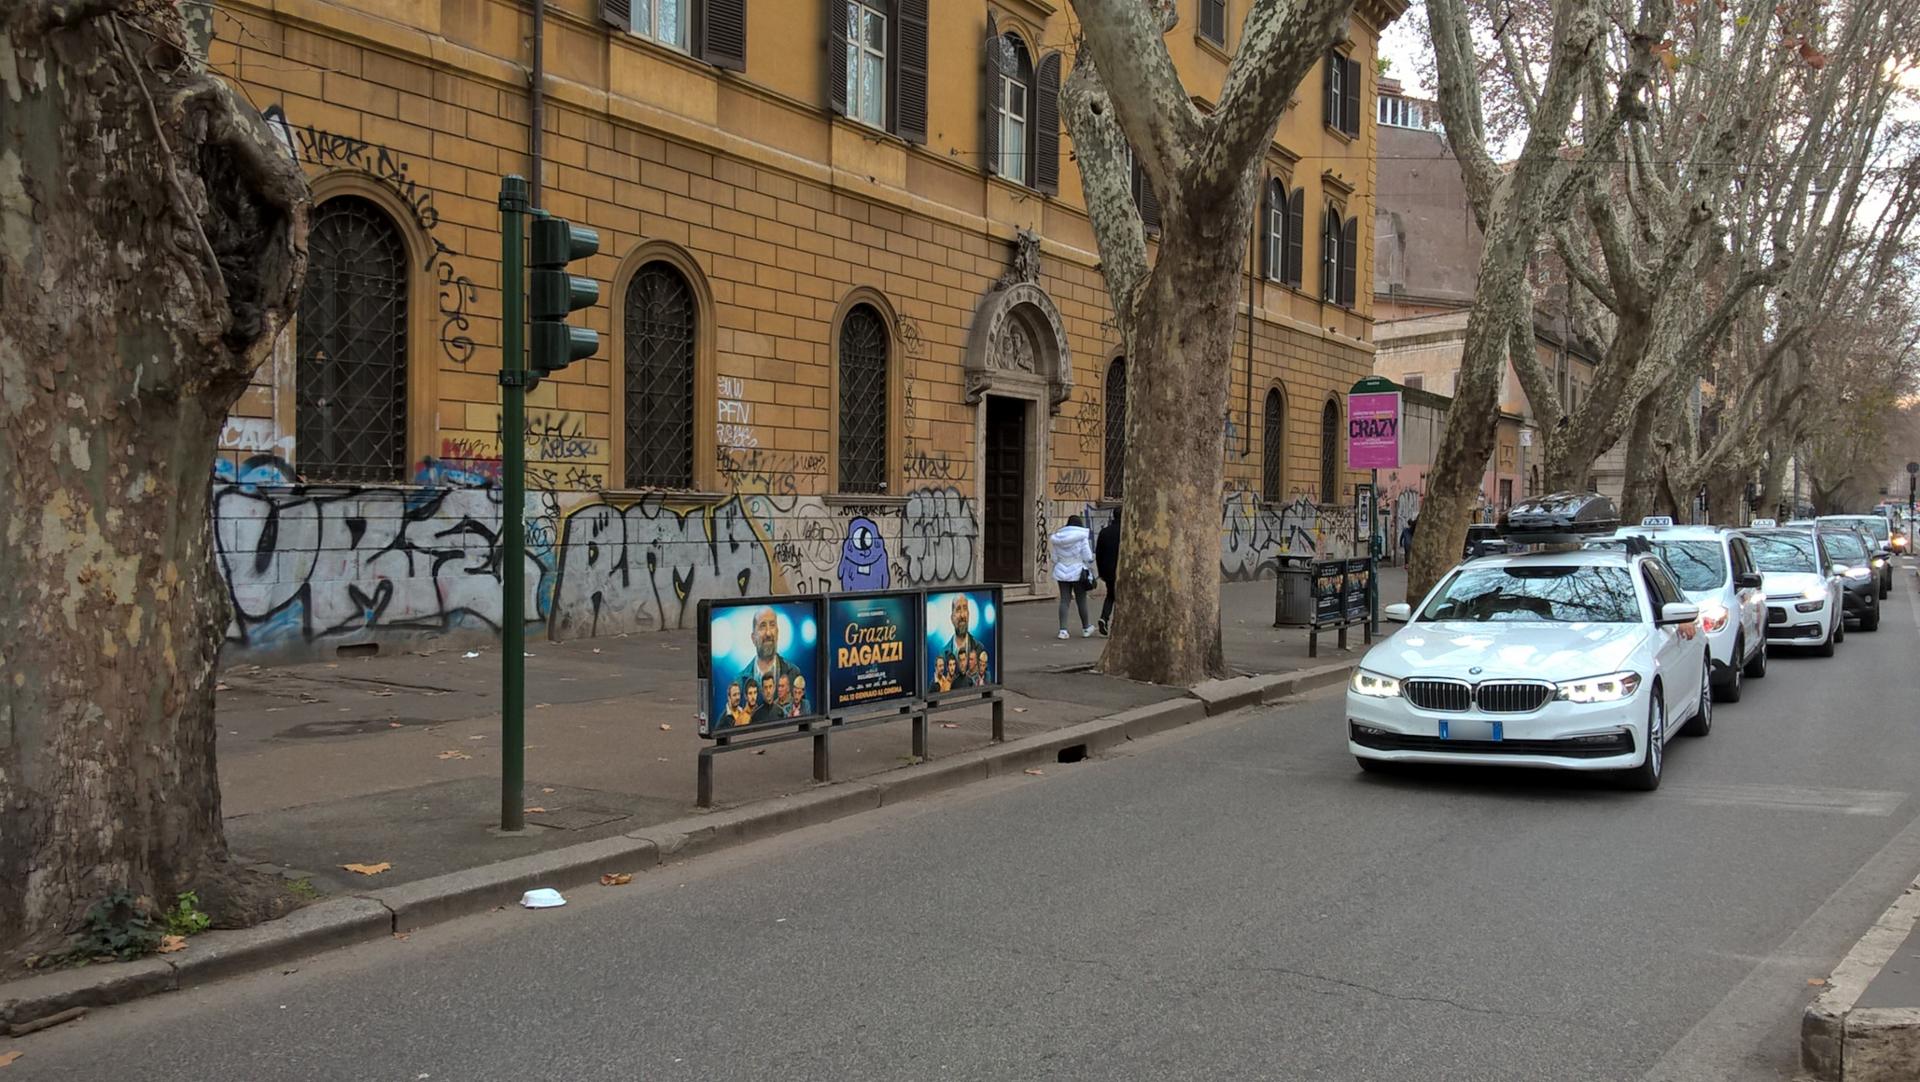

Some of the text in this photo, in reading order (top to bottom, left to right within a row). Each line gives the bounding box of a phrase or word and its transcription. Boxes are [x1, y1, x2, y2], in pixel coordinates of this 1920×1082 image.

[1350, 418, 1398, 438] CRAZY
[1643, 518, 1670, 526] TAXI
[845, 619, 897, 645] Grazie
[838, 641, 903, 669] RAGAZZI
